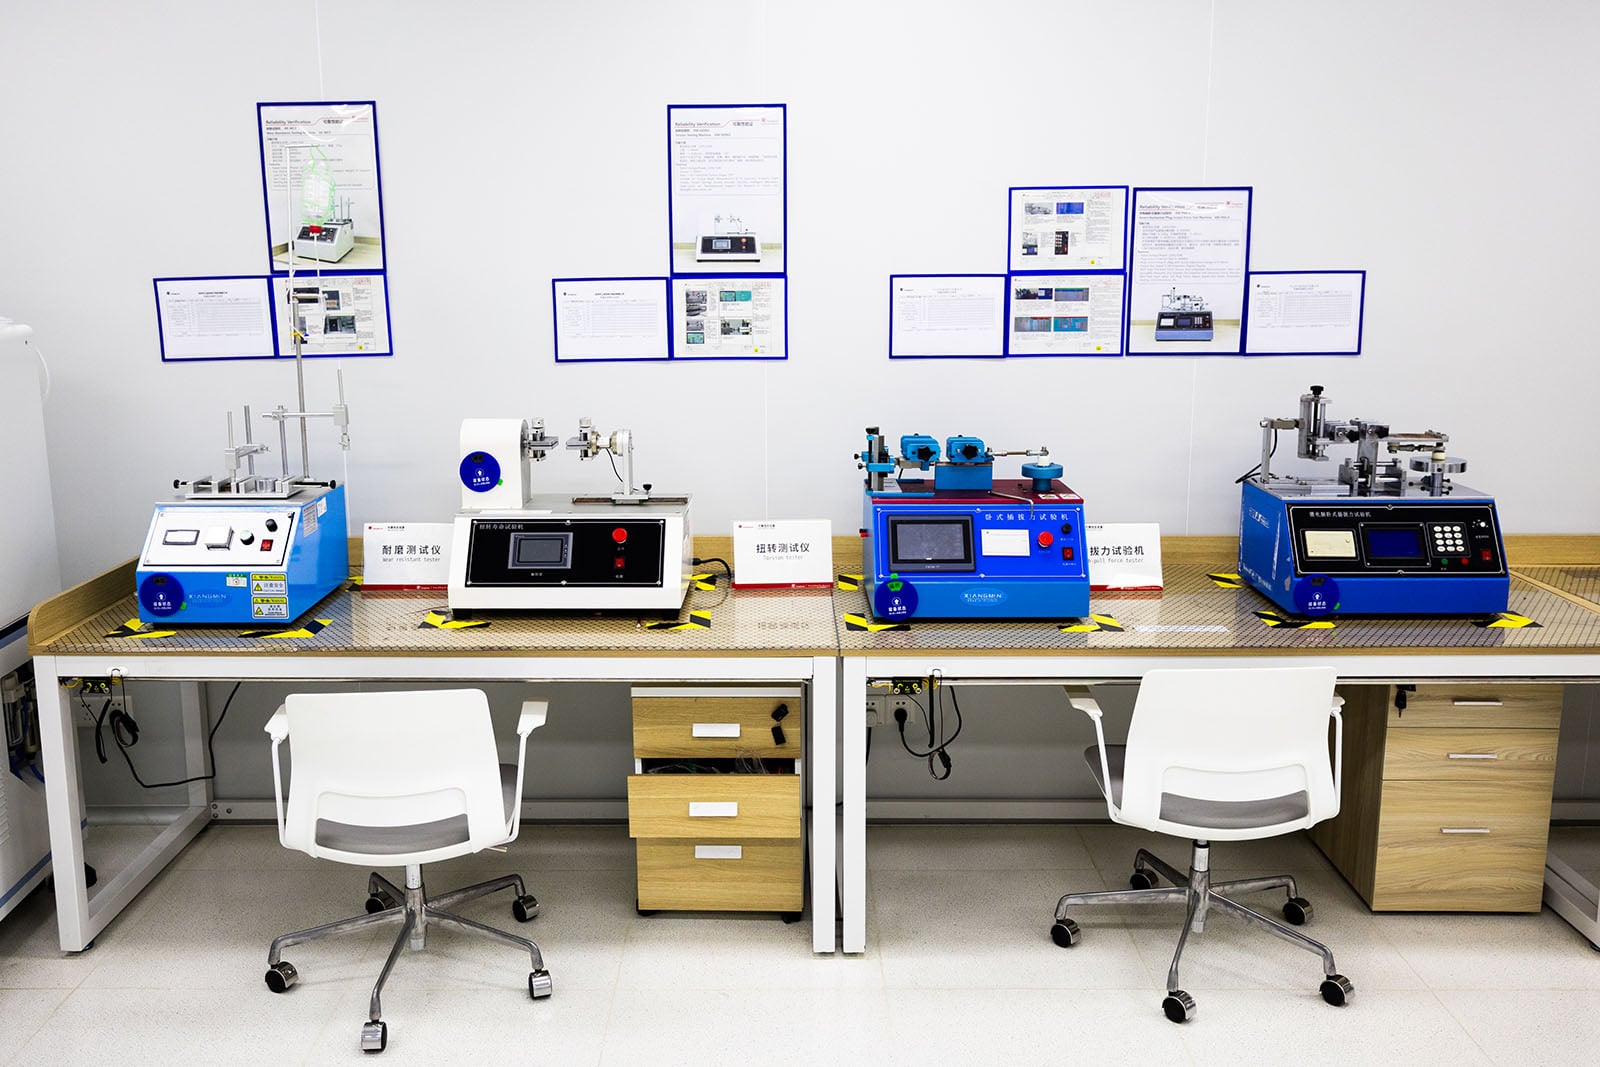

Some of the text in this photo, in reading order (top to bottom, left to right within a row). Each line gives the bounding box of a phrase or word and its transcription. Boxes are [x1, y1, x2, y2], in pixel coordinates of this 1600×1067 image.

[382, 544, 441, 555] 耐磨测试仪
[756, 542, 810, 554] 扭转测试仪
[1090, 545, 1145, 556] 拔力试验机
